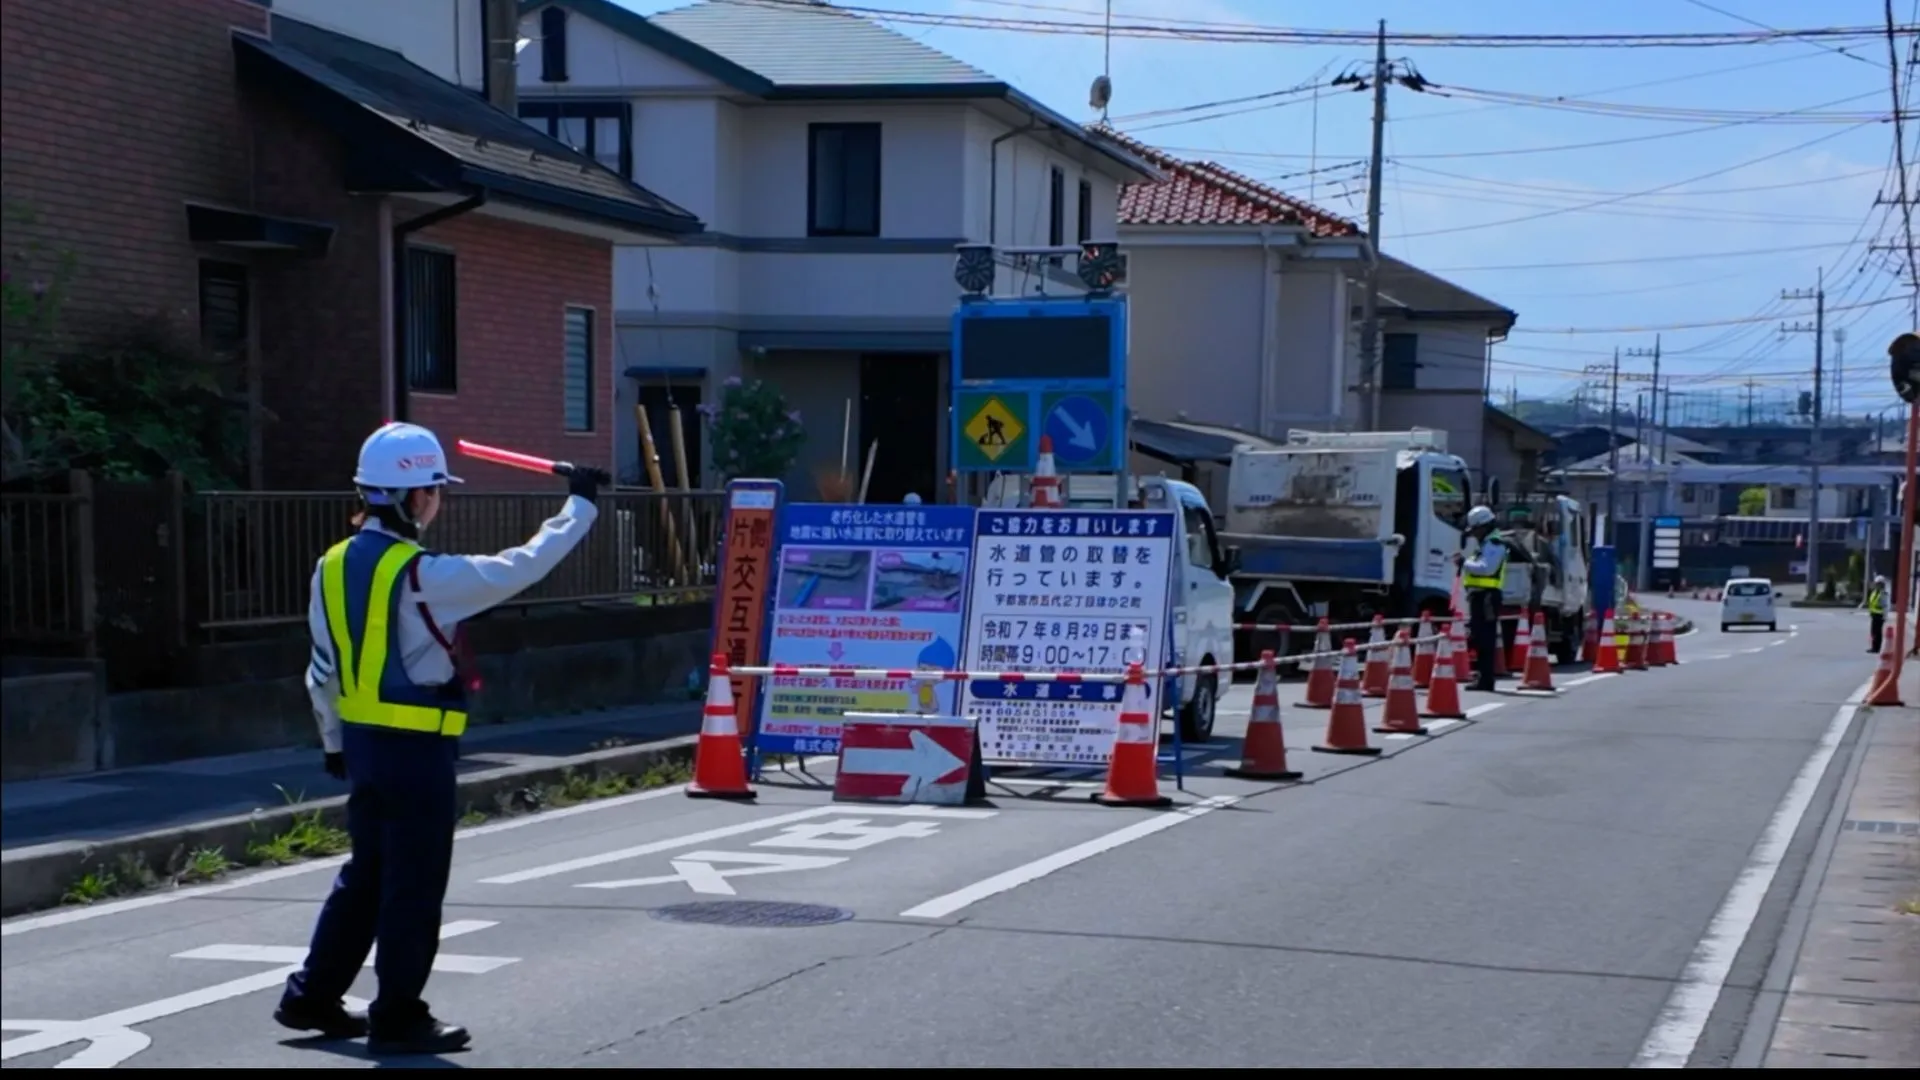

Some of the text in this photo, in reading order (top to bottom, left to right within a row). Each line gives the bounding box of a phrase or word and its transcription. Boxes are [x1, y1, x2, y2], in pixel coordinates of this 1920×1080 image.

[831, 510, 926, 525] 老朽化した水道管を
[991, 517, 1158, 535] ご協力をお願いします
[790, 525, 965, 542] 地震に強い水道管に取り替えています
[989, 544, 1151, 564] 水道管の取替を
[987, 568, 1142, 589] 行っています。
[1003, 683, 1116, 700] 水道工事
[793, 739, 841, 753] 株式会
